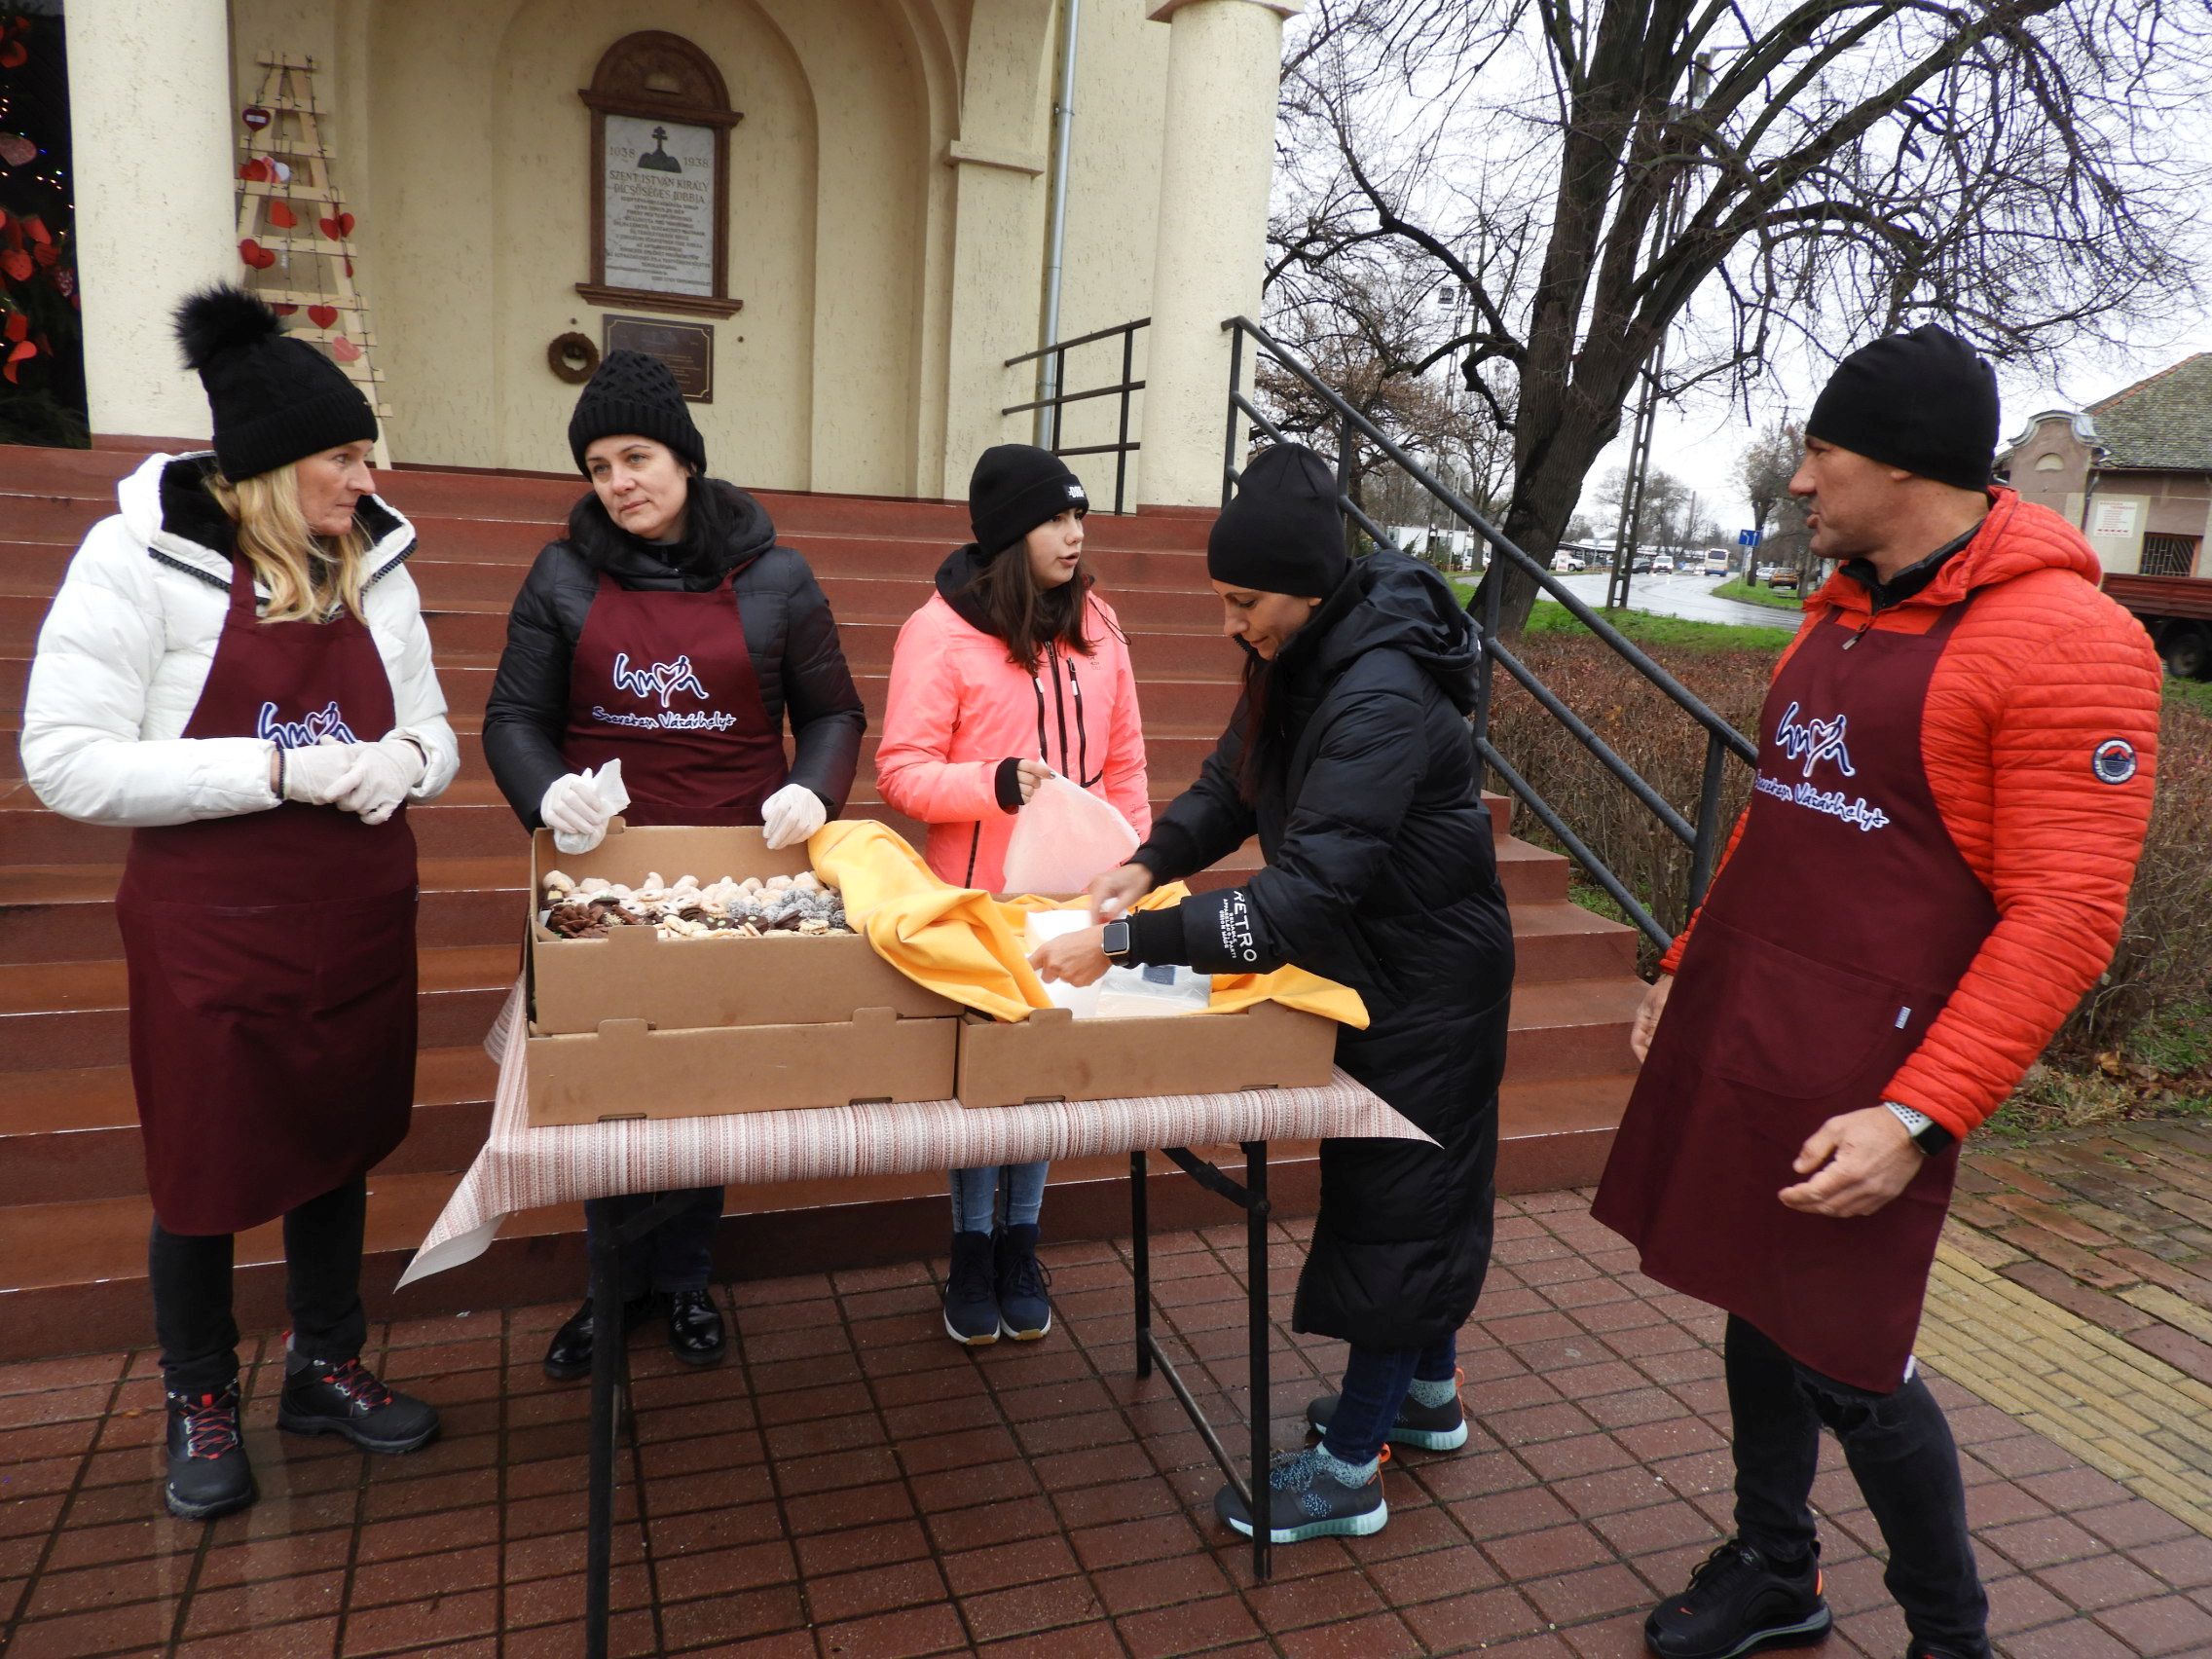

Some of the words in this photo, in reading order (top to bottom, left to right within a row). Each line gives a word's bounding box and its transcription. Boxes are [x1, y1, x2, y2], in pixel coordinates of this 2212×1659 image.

[609, 146, 636, 159] 1038
[684, 157, 710, 168] 1938
[609, 169, 638, 181] SZENT
[677, 178, 709, 192] KIRÁLY
[1233, 890, 1258, 962] RETRO
